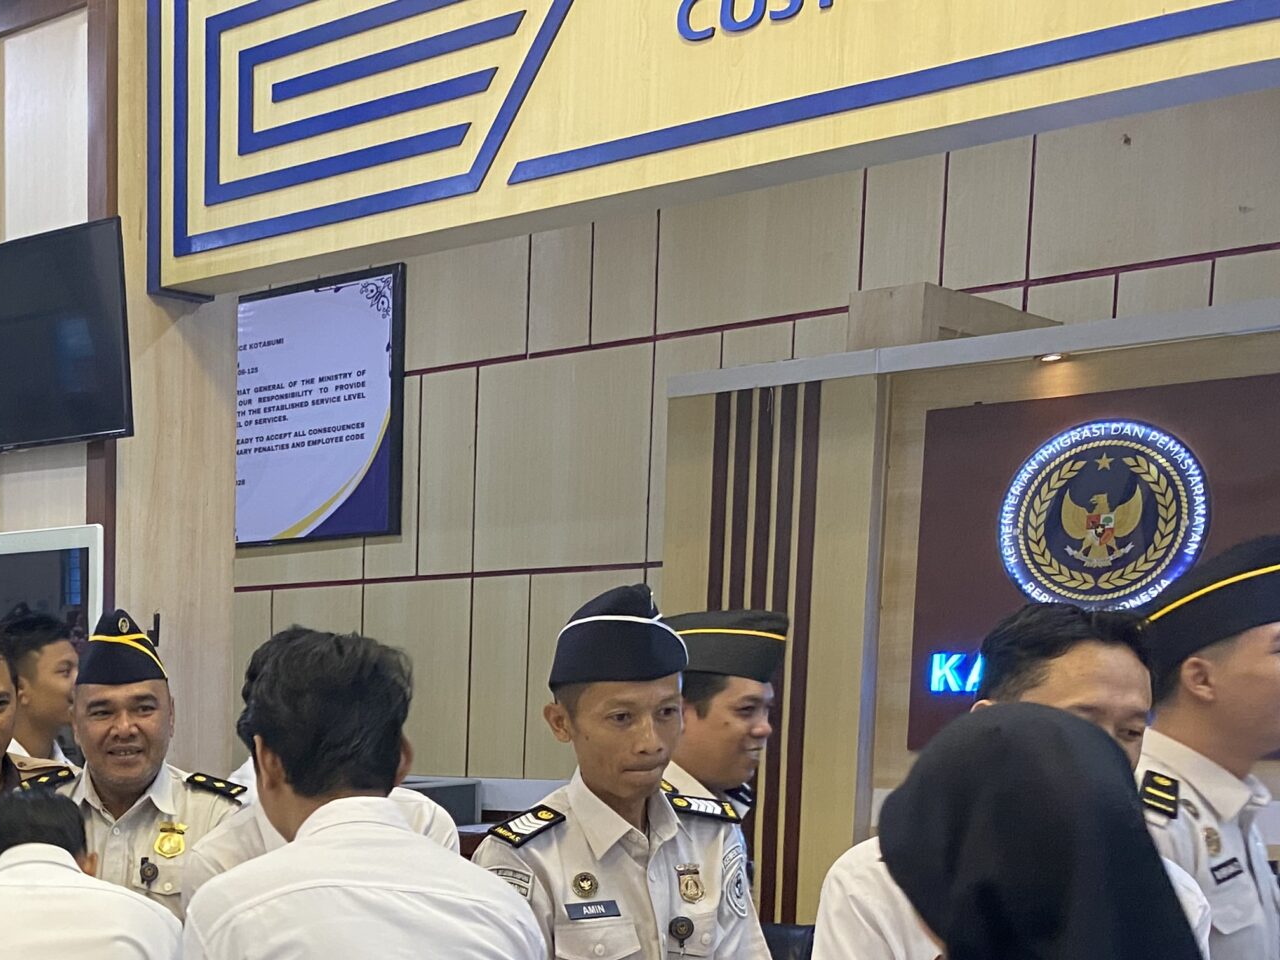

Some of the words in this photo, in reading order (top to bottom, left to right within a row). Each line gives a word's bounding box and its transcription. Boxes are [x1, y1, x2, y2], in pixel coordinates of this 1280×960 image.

[254, 383, 285, 393] GENERAL
[301, 378, 315, 386] THE
[319, 372, 352, 383] MINISTRY
[357, 369, 366, 377] OF
[258, 389, 312, 404] RESPONSIBILITY
[335, 381, 366, 392] PROVIDE
[248, 408, 261, 416] THE
[263, 401, 309, 414] ESTABLISHED
[311, 395, 341, 406] SERVICE
[344, 392, 366, 401] LEVEL
[254, 443, 289, 454] PENALTIES
[291, 441, 305, 449] AND
[307, 436, 344, 447] EMPLOYEE
[345, 433, 365, 441] CODE
[255, 435, 264, 443] TO
[266, 432, 293, 441] ACCEPT
[294, 430, 306, 438] ALL
[308, 422, 365, 436] CONSEQUENCES
[1001, 463, 1039, 566] KEMENTERIAN
[1037, 424, 1105, 462] IMIGRASI
[1111, 424, 1145, 440] DAN
[1148, 431, 1206, 556] PEMASYARAKATAN
[582, 904, 606, 915] AMIN
